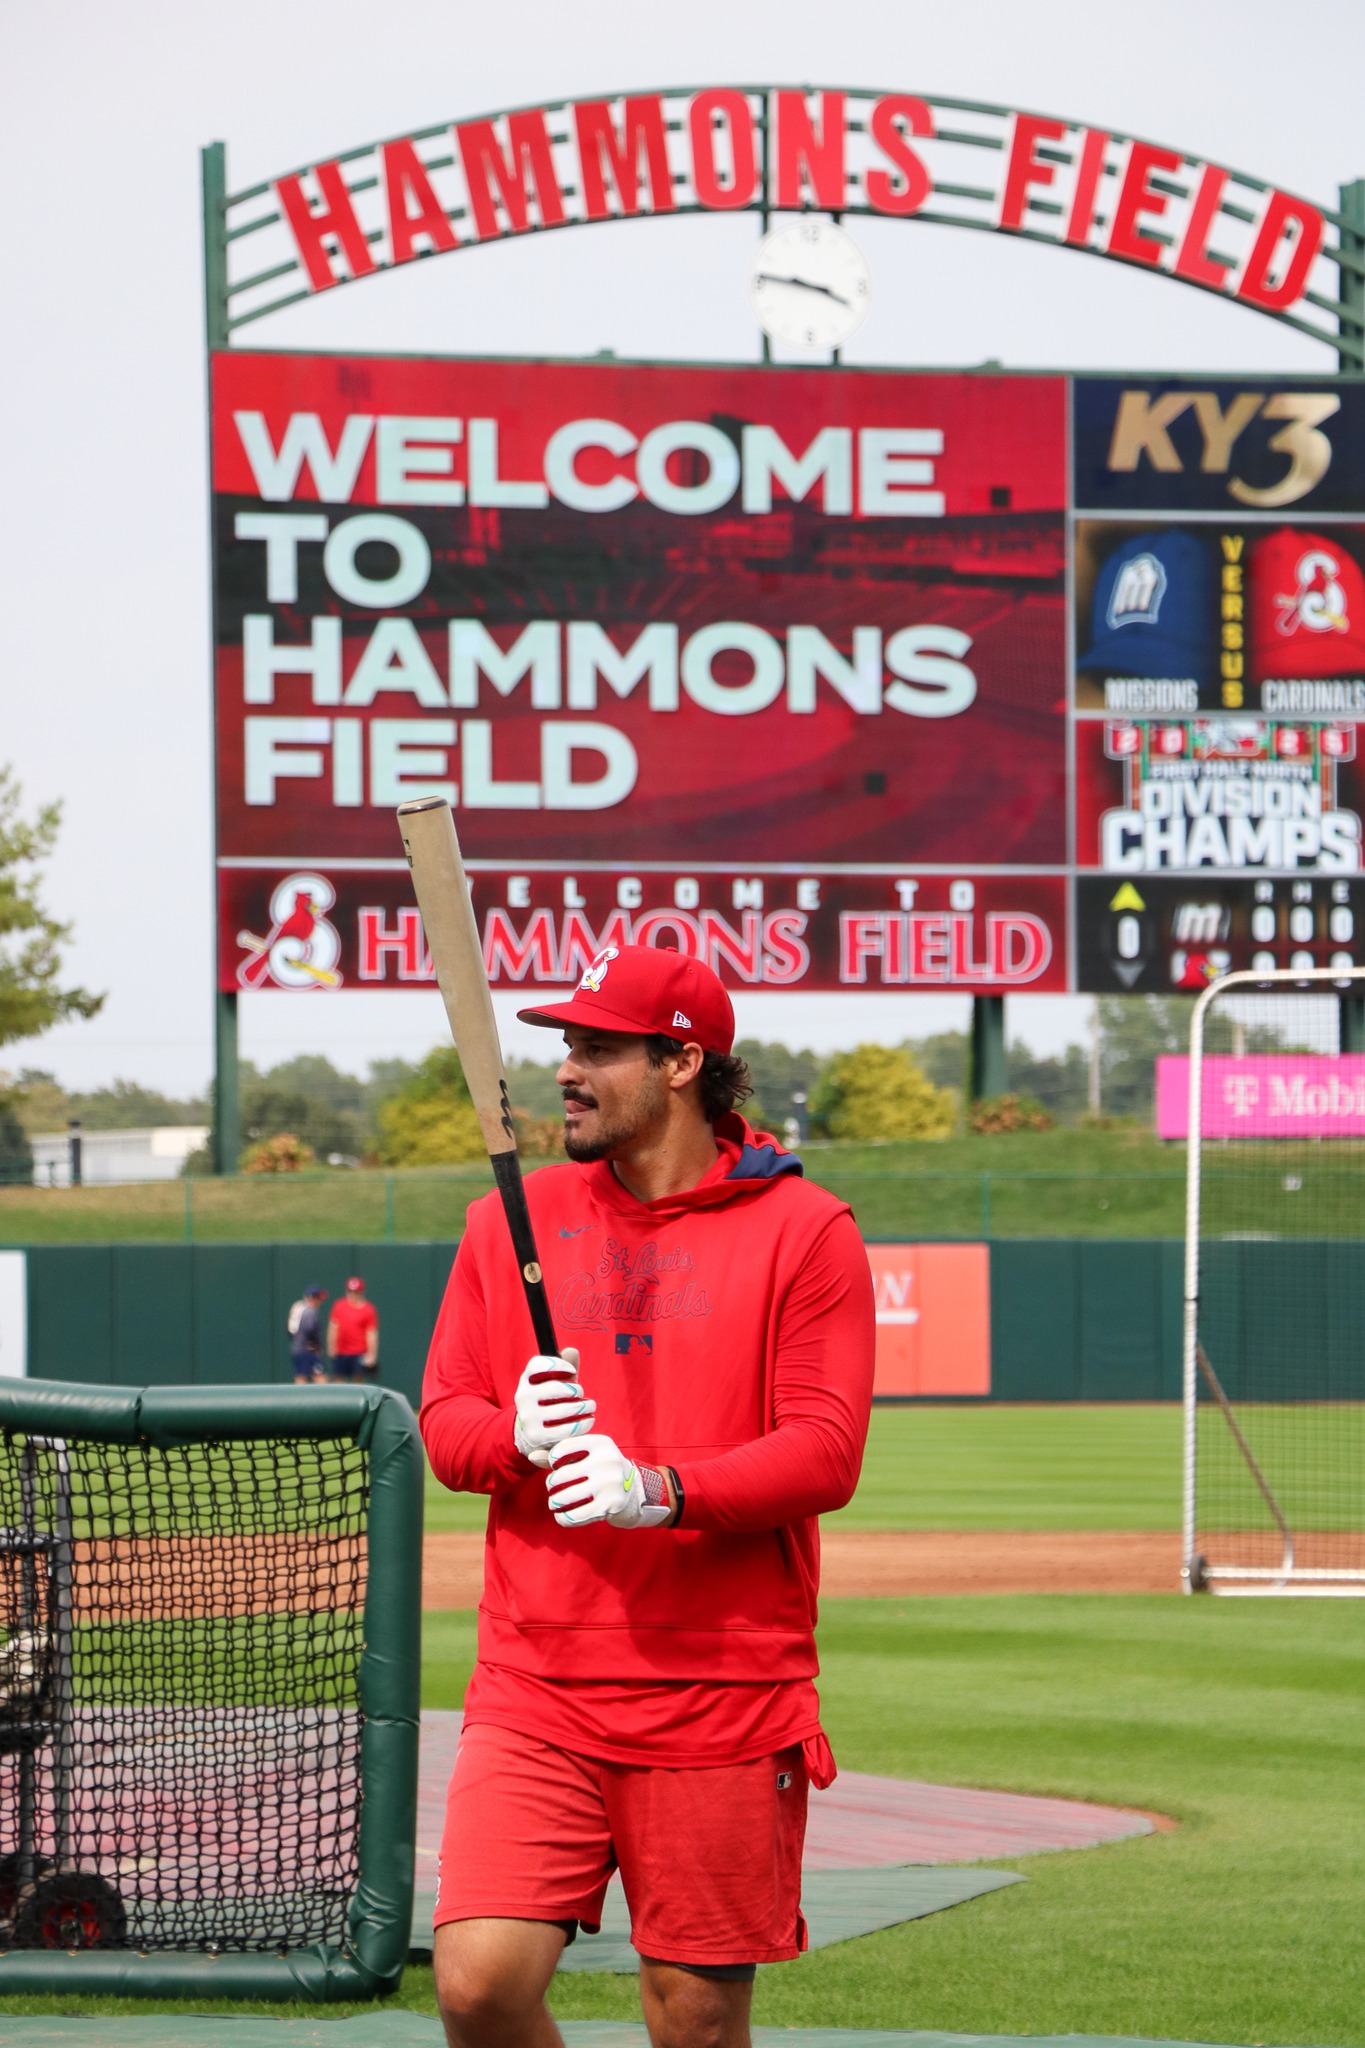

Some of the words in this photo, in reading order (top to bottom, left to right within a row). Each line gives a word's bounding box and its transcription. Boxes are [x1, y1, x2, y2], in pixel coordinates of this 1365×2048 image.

[273, 86, 936, 293] HAMMONS
[996, 111, 1326, 314] FIELD
[233, 411, 945, 517] WELCOME
[1107, 390, 1341, 507] KY3
[235, 512, 431, 608] TO
[1220, 535, 1244, 709] VERSUS
[243, 614, 977, 718] HAMMONS
[1104, 677, 1199, 712] MISSIONS
[245, 715, 639, 809] FIELD
[1142, 779, 1321, 819] DIVISION
[1103, 812, 1360, 873] CHAMPS
[895, 879, 975, 912] TO
[839, 910, 1053, 984] FIELD
[552, 1270, 713, 1332] Cardinals
[622, 1241, 695, 1285] Louis
